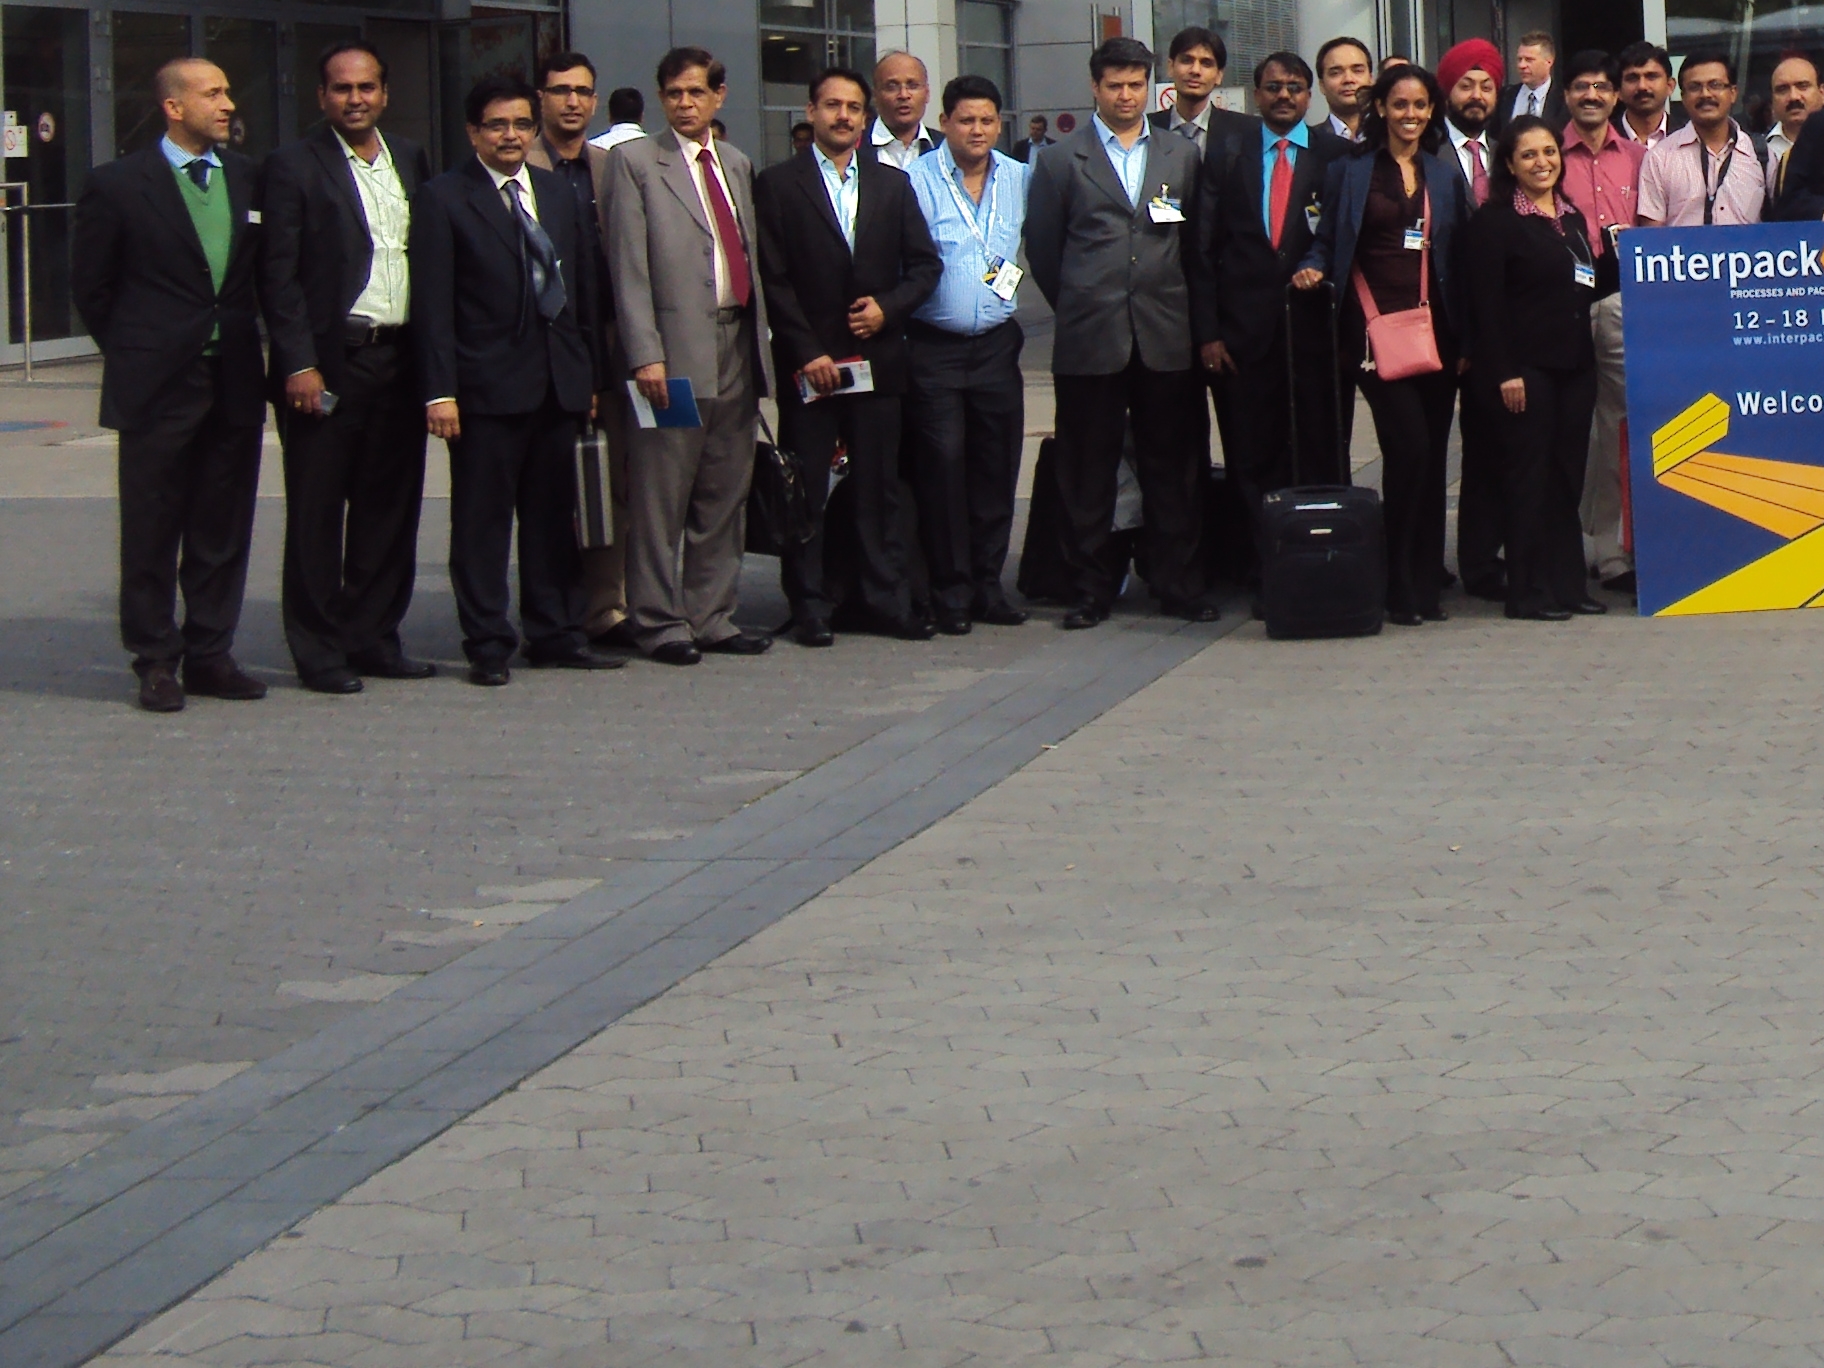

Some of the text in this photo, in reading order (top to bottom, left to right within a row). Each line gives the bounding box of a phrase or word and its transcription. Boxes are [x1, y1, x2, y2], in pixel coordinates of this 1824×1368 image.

[1634, 240, 1822, 288] interpack
[1730, 288, 1783, 299] PROCESSES
[1786, 287, 1805, 297] AND
[1733, 311, 1760, 329] 12
[1782, 309, 1808, 328] 18
